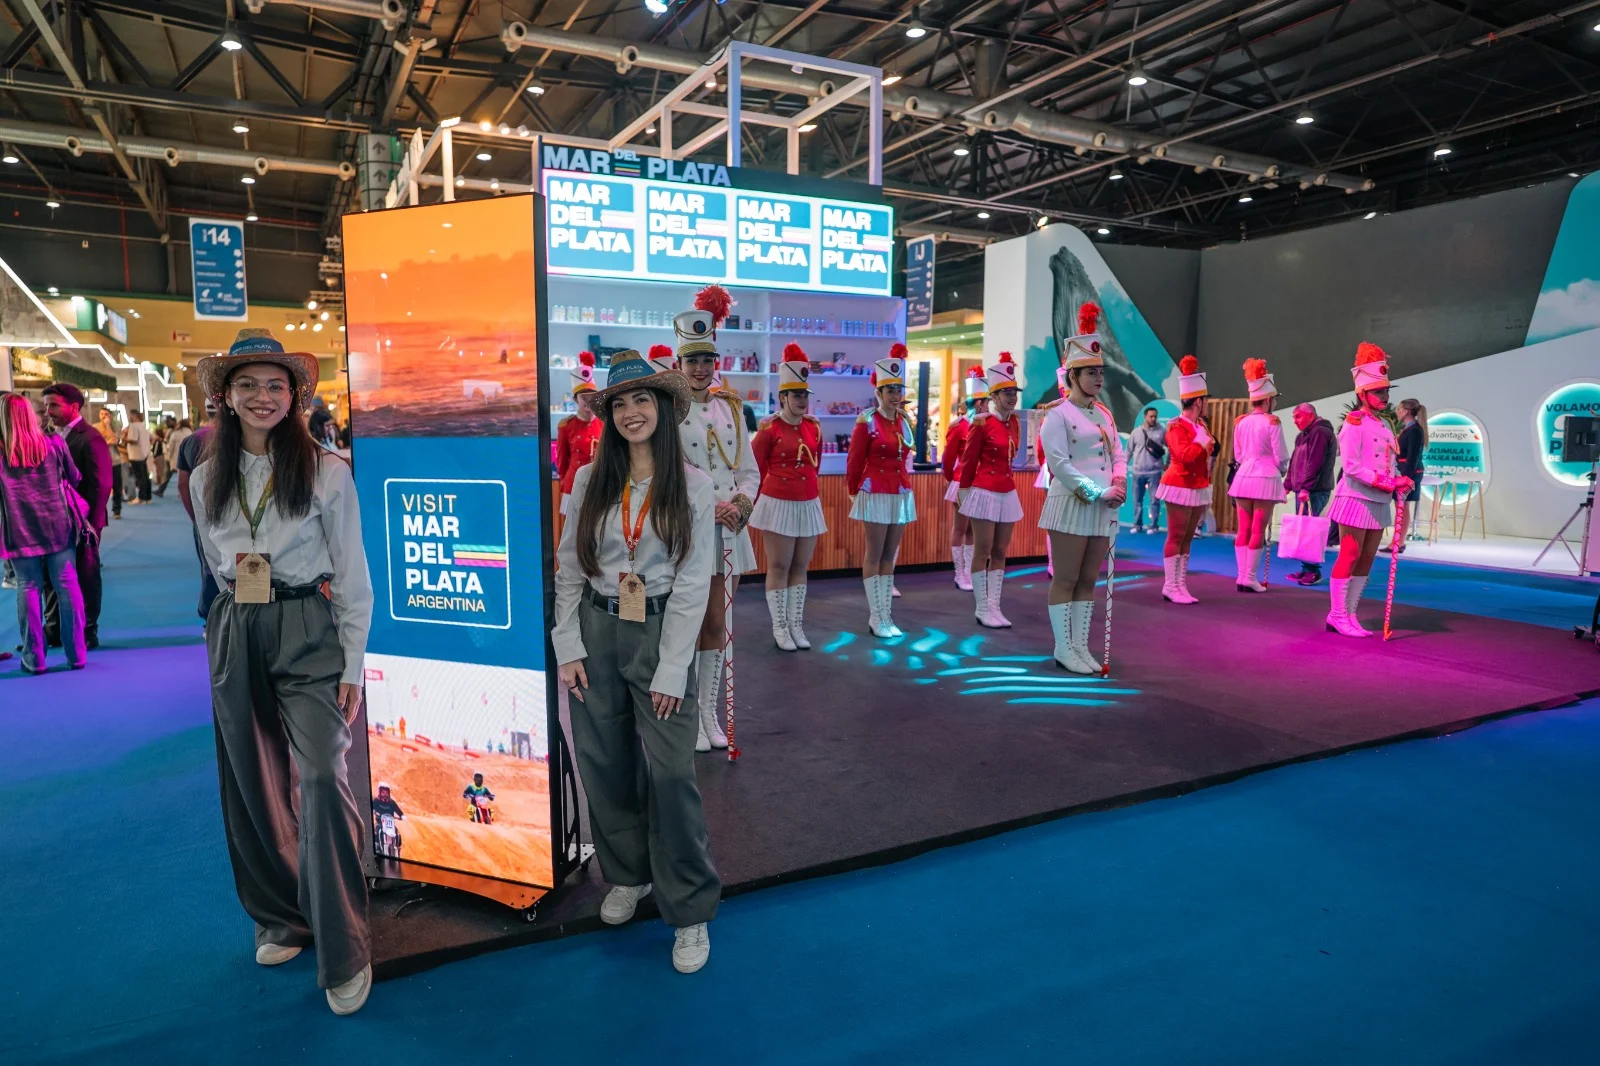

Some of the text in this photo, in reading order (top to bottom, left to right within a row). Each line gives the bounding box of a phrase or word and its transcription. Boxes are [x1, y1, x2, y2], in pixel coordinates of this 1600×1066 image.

[544, 146, 732, 187] MAR DEL PLATA
[550, 180, 610, 205] MAR
[649, 190, 705, 215] MAR
[551, 204, 602, 227] DEL
[738, 199, 791, 223] MAR
[823, 208, 872, 231] MAR
[208, 227, 231, 246] 14
[649, 213, 697, 236] DEL
[738, 221, 783, 243] DEL
[551, 228, 632, 254] PLATA
[649, 235, 724, 261] PLATA
[823, 229, 864, 250] DEL
[738, 243, 808, 267] PLATA
[823, 250, 887, 274] PLATA
[1428, 432, 1468, 440] dvantage
[402, 493, 457, 513] VISIT
[403, 514, 460, 538] MAR
[404, 541, 452, 565] DEL
[405, 568, 484, 594] PLATA
[407, 594, 486, 613] ARGENTINA
